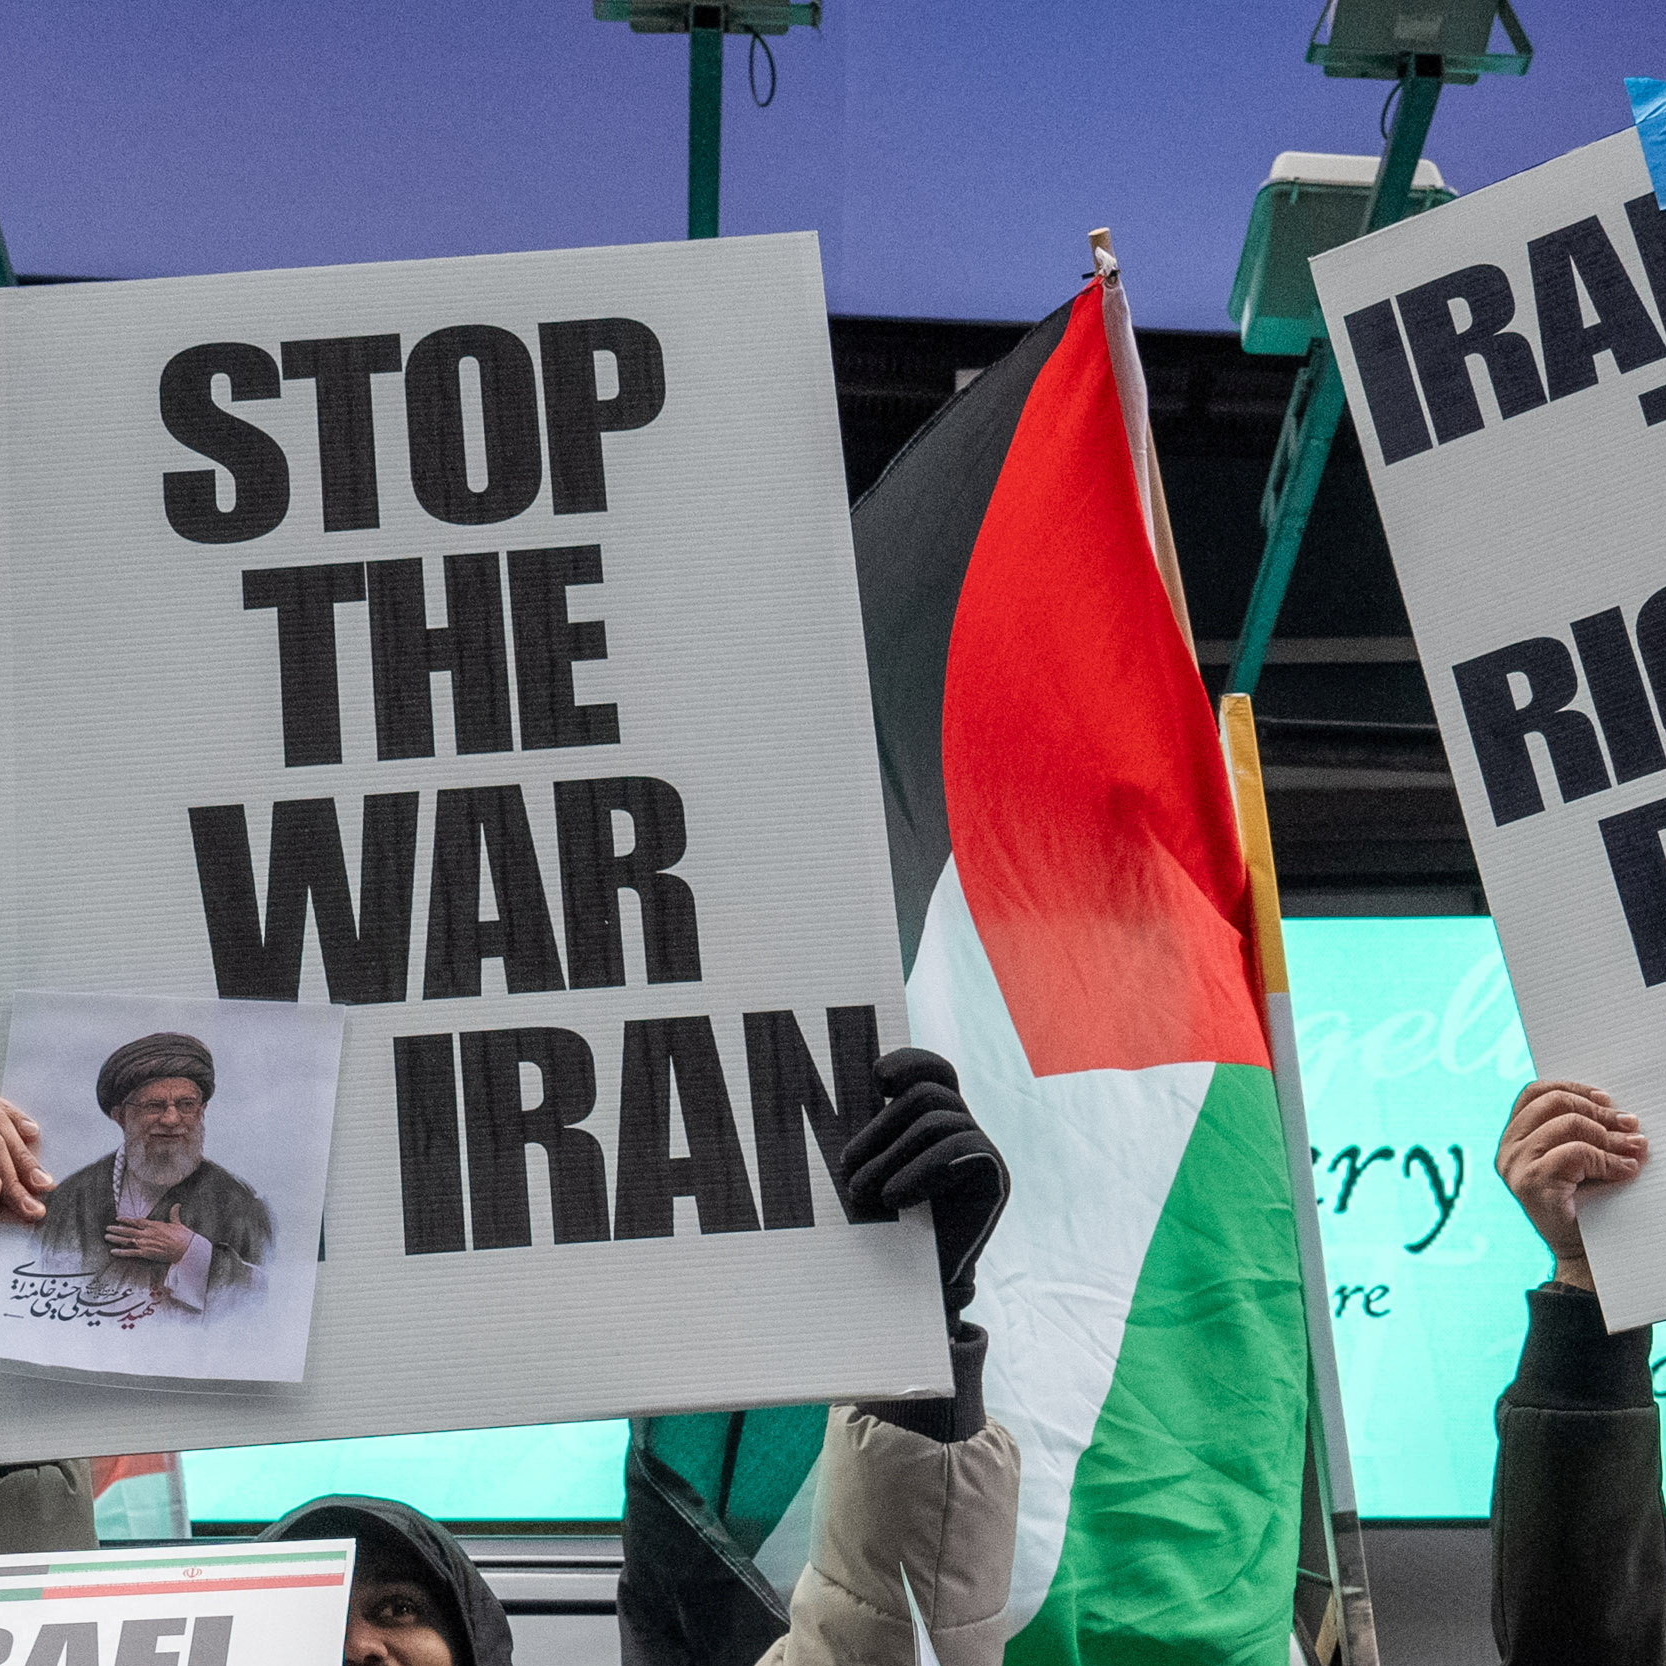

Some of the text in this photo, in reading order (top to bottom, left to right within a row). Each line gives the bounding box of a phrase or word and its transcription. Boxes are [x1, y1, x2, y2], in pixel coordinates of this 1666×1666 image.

[158, 317, 665, 545] STOP
[241, 544, 620, 767] THE
[187, 776, 702, 1006] WAR
[392, 1005, 901, 1256] IRAN
